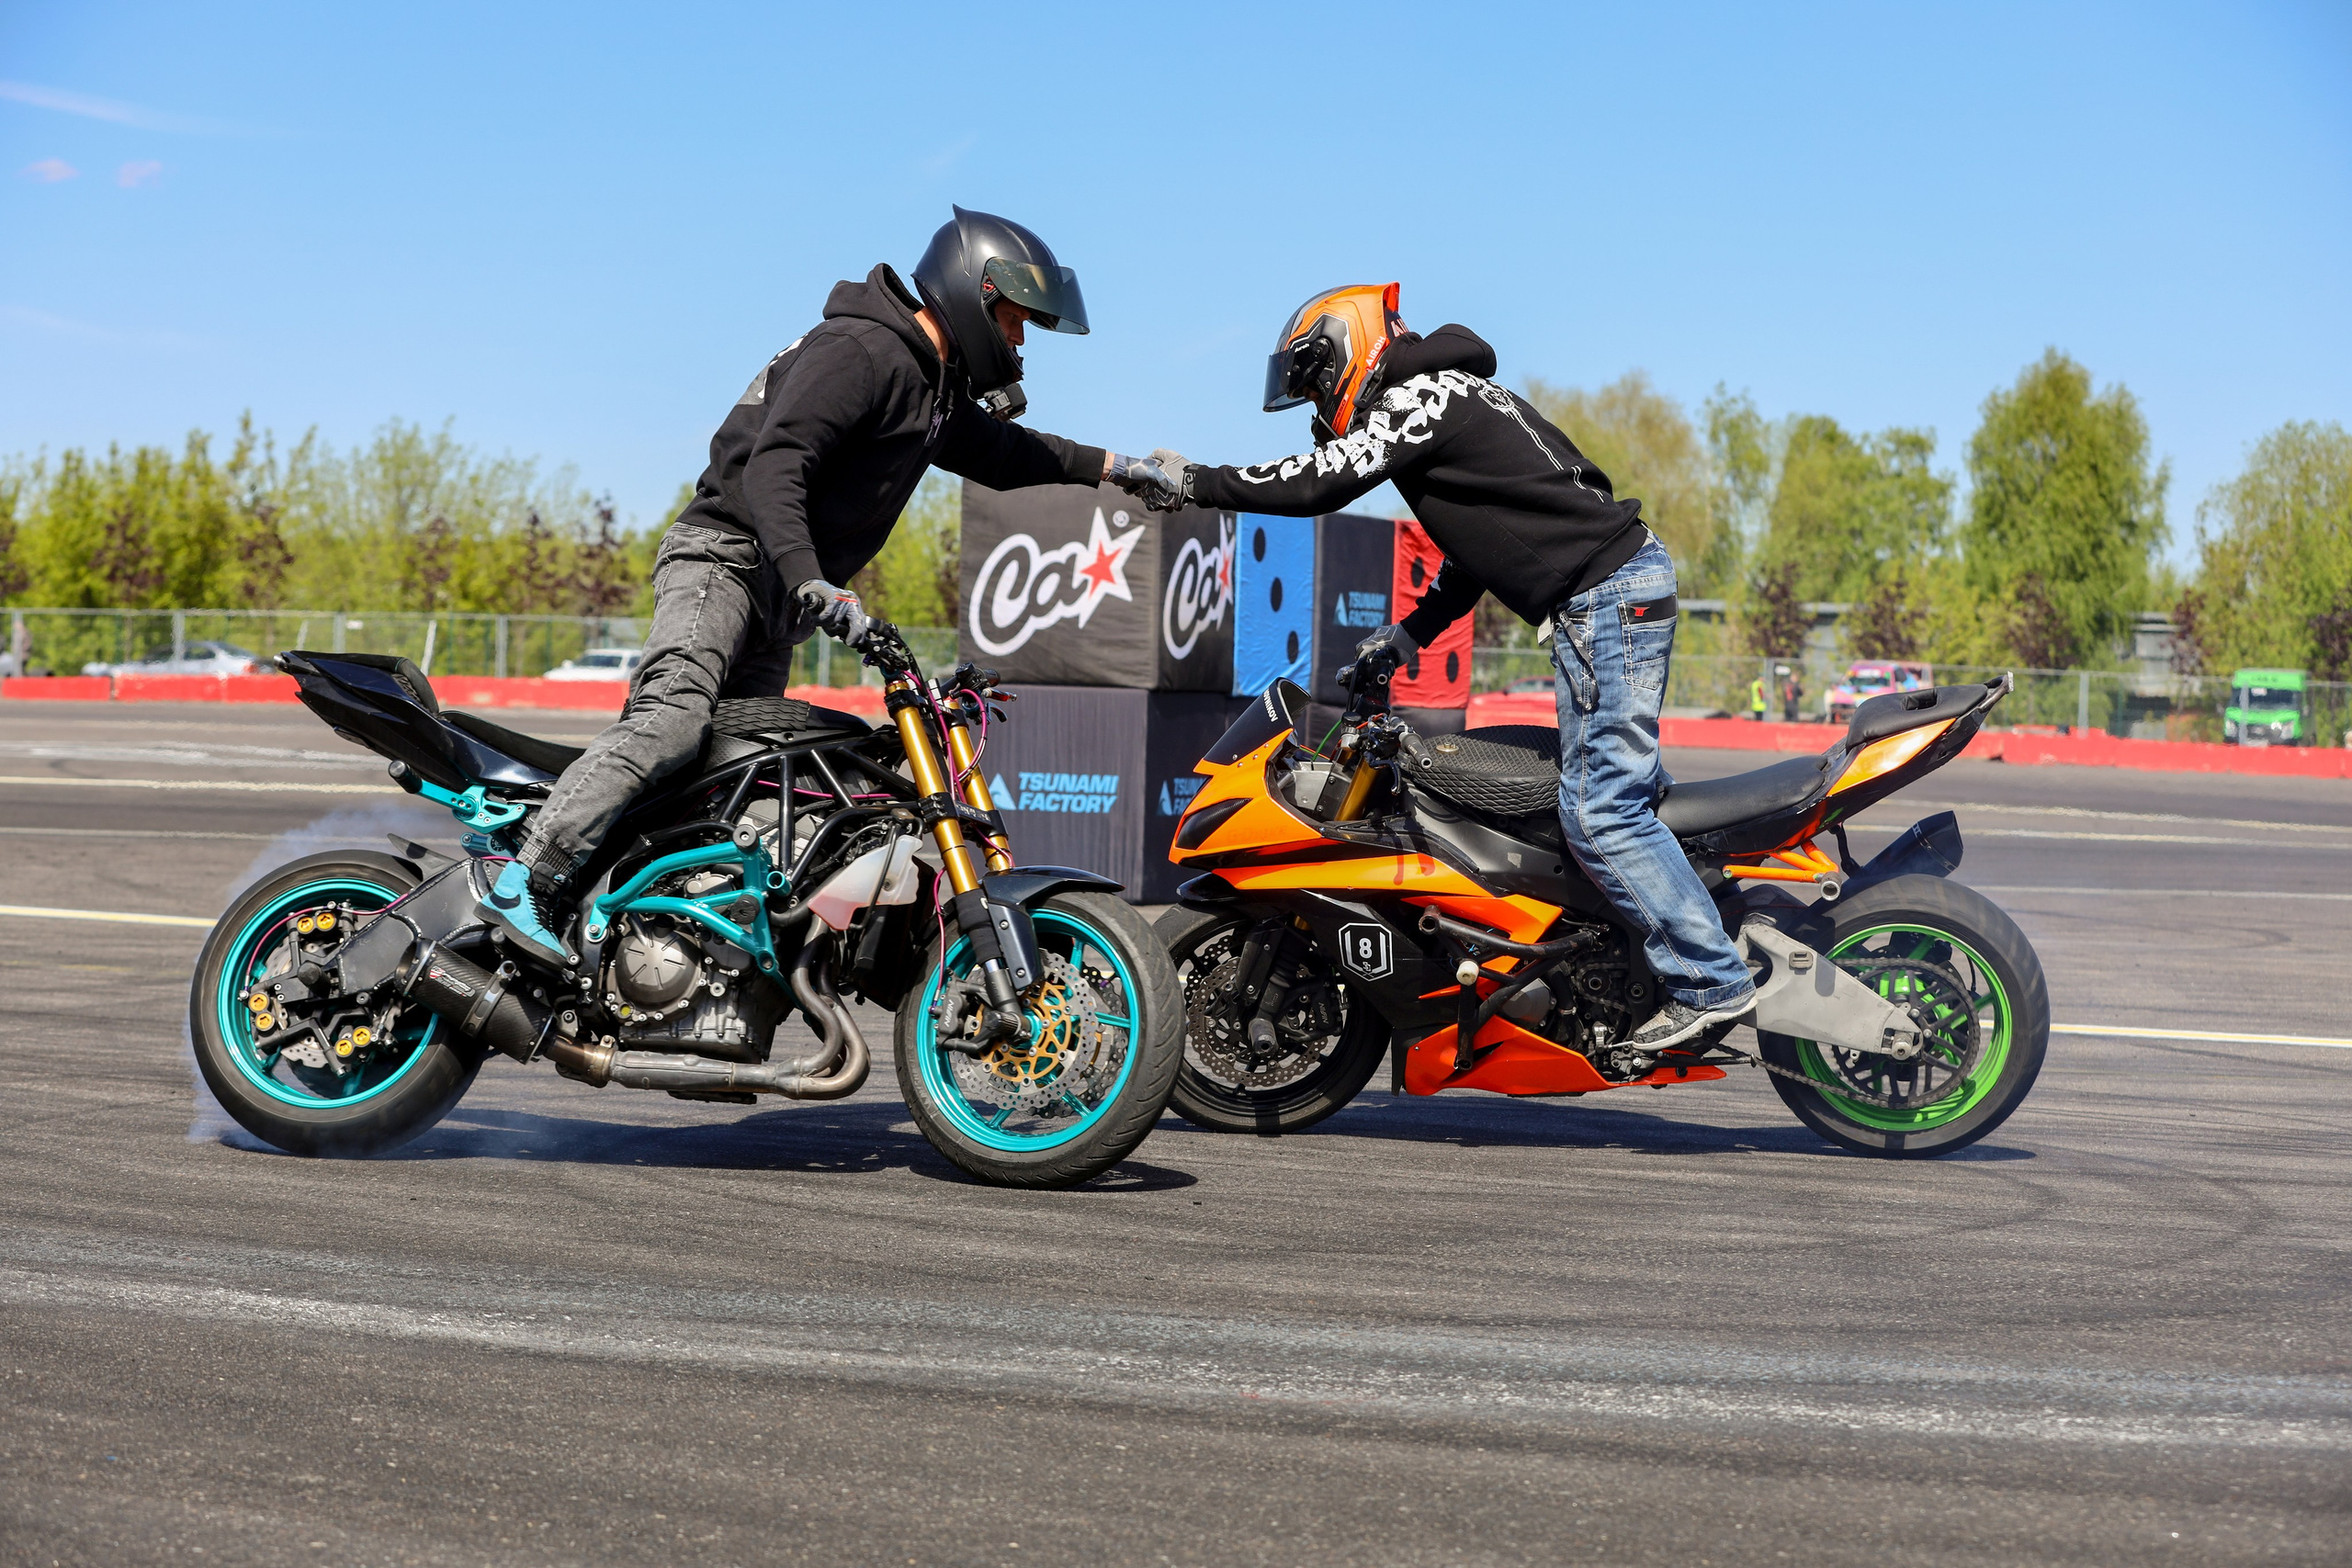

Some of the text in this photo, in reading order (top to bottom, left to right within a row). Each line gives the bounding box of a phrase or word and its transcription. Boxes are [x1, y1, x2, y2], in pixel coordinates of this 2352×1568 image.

[1365, 335, 1386, 367] AIROH
[1349, 591, 1386, 610] TSUNAMI
[1349, 609, 1385, 628] FACTORY
[1018, 772, 1119, 794] TSUNAMI
[1018, 792, 1117, 813] FACTORY
[1359, 938, 1373, 959] 8
